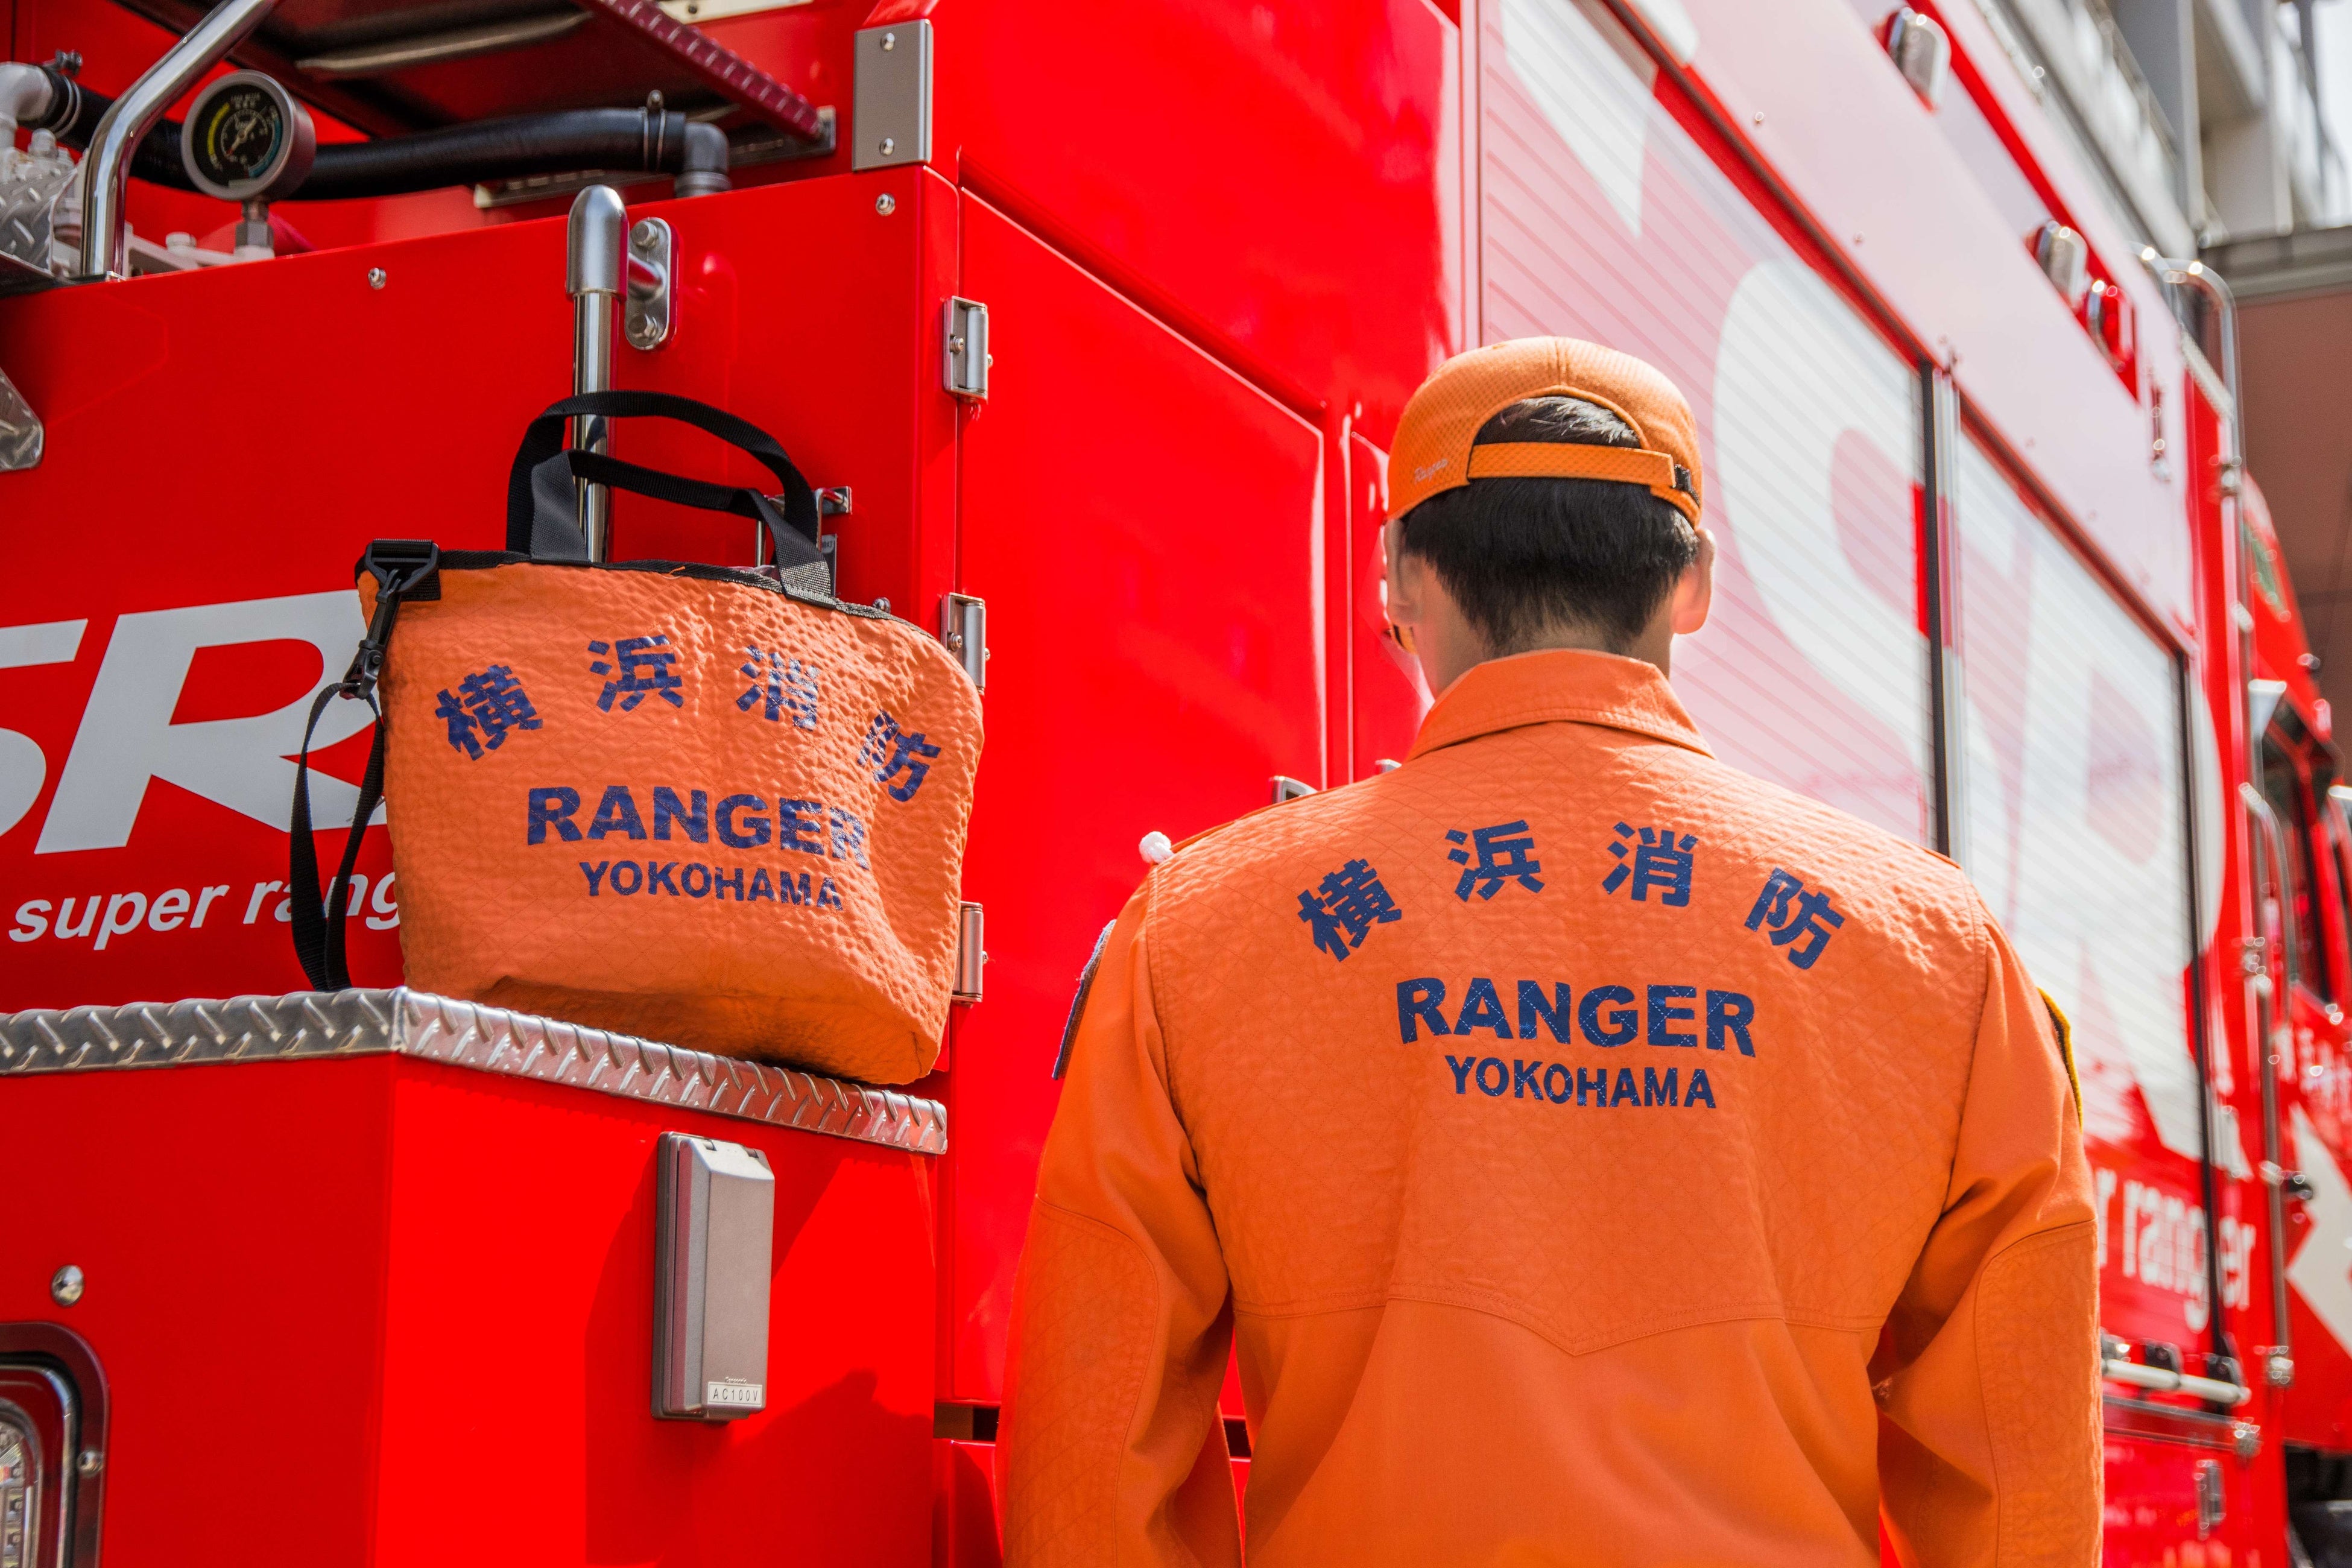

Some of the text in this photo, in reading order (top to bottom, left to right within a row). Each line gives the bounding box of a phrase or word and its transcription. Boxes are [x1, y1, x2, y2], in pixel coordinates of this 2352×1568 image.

[0, 589, 387, 854] R
[436, 634, 941, 802] 横浜消防
[528, 786, 869, 868] RANGER
[8, 885, 230, 950] super
[580, 861, 844, 910] YOKOHAMA
[1298, 820, 1844, 969] 横浜消防
[1397, 978, 1756, 1057] RANGER
[1445, 1055, 1715, 1108] YOKOHAMA
[2123, 1180, 2256, 1333] ranger
[713, 1388, 758, 1402] AC100V
